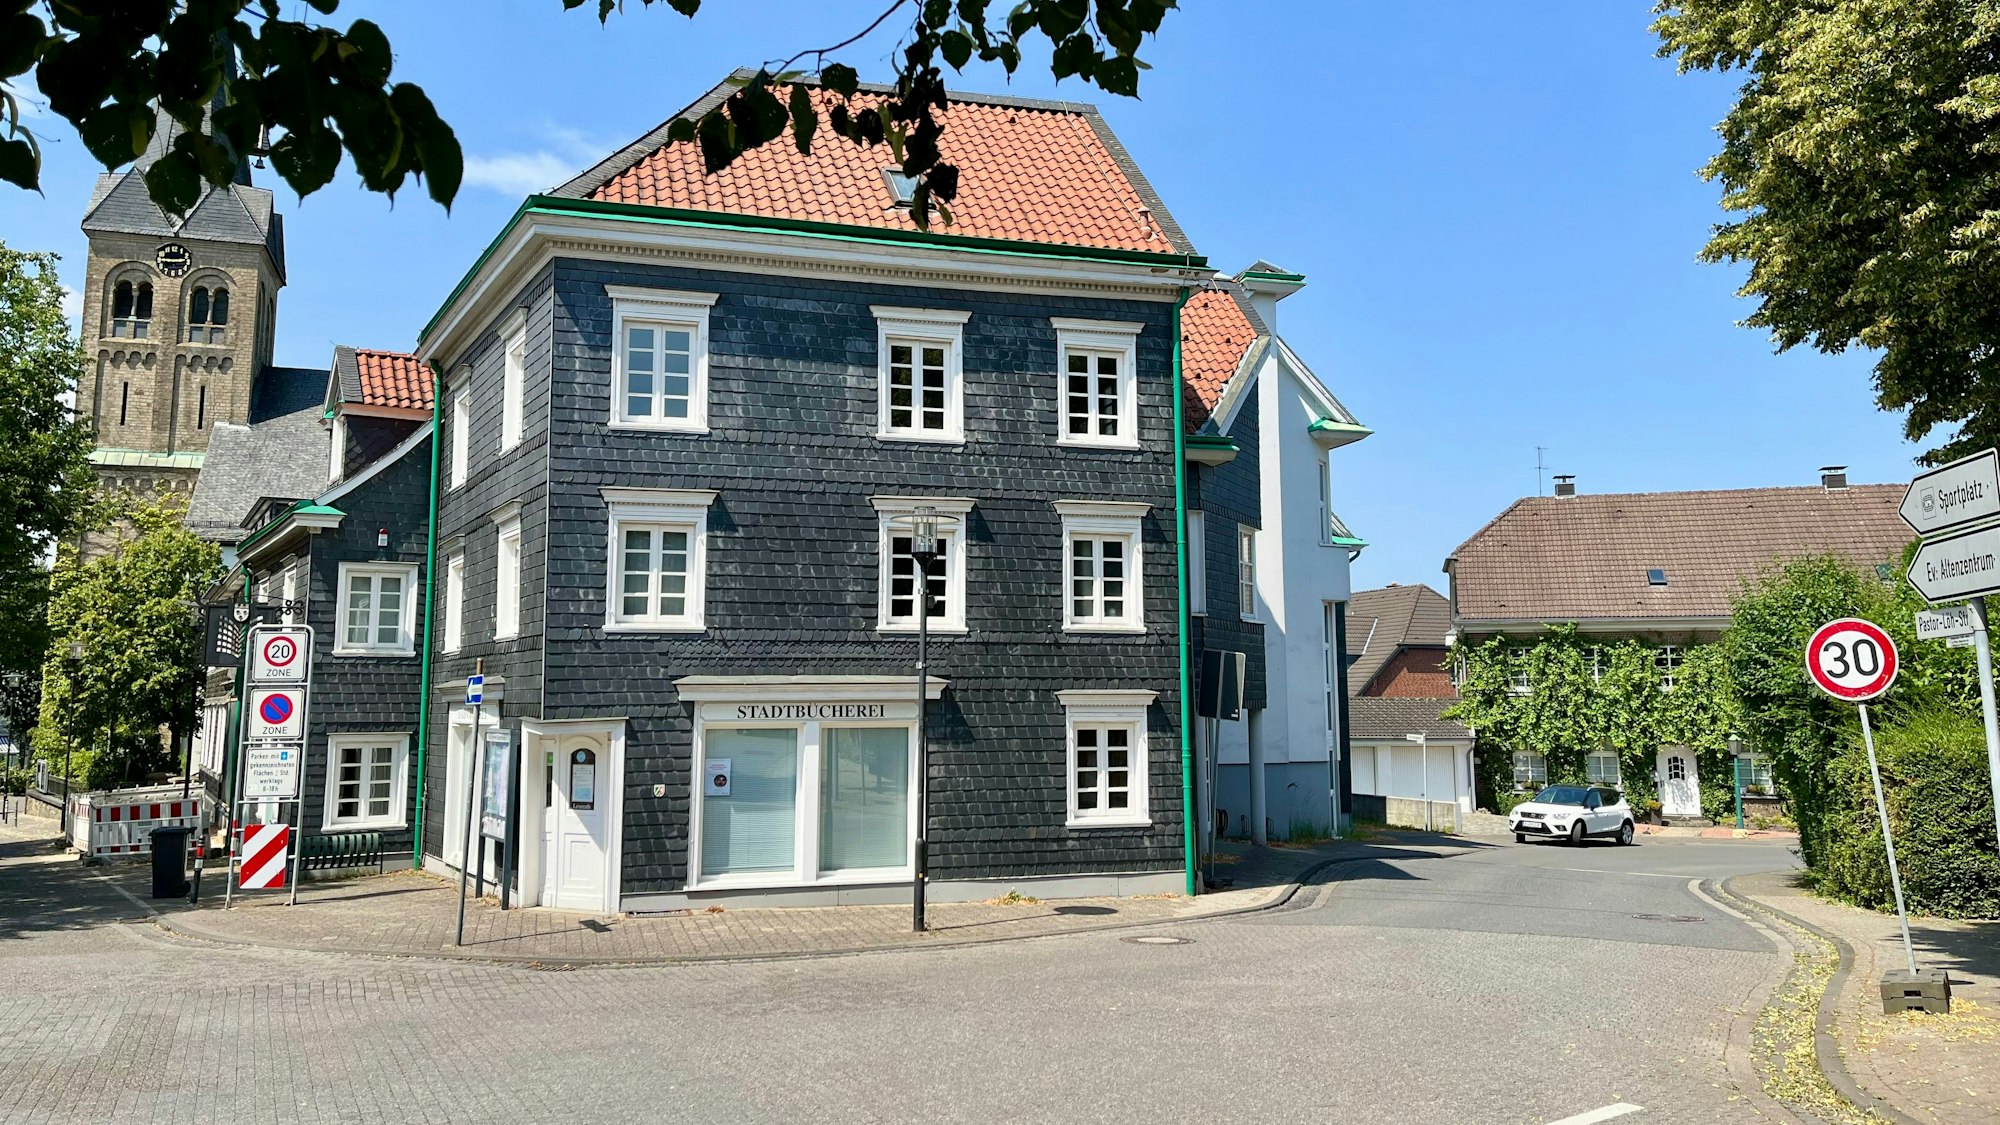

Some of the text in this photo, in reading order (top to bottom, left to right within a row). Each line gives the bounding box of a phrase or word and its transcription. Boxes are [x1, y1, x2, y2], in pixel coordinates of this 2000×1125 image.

[1938, 479, 1983, 514] Sportplatz
[1940, 552, 1994, 580] Altenzentrum
[271, 644, 290, 658] 20
[1823, 638, 1879, 678] 30
[266, 668, 291, 677] ZONE
[737, 702, 886, 719] STADTBÜCHEREI
[262, 726, 288, 734] ZONE
